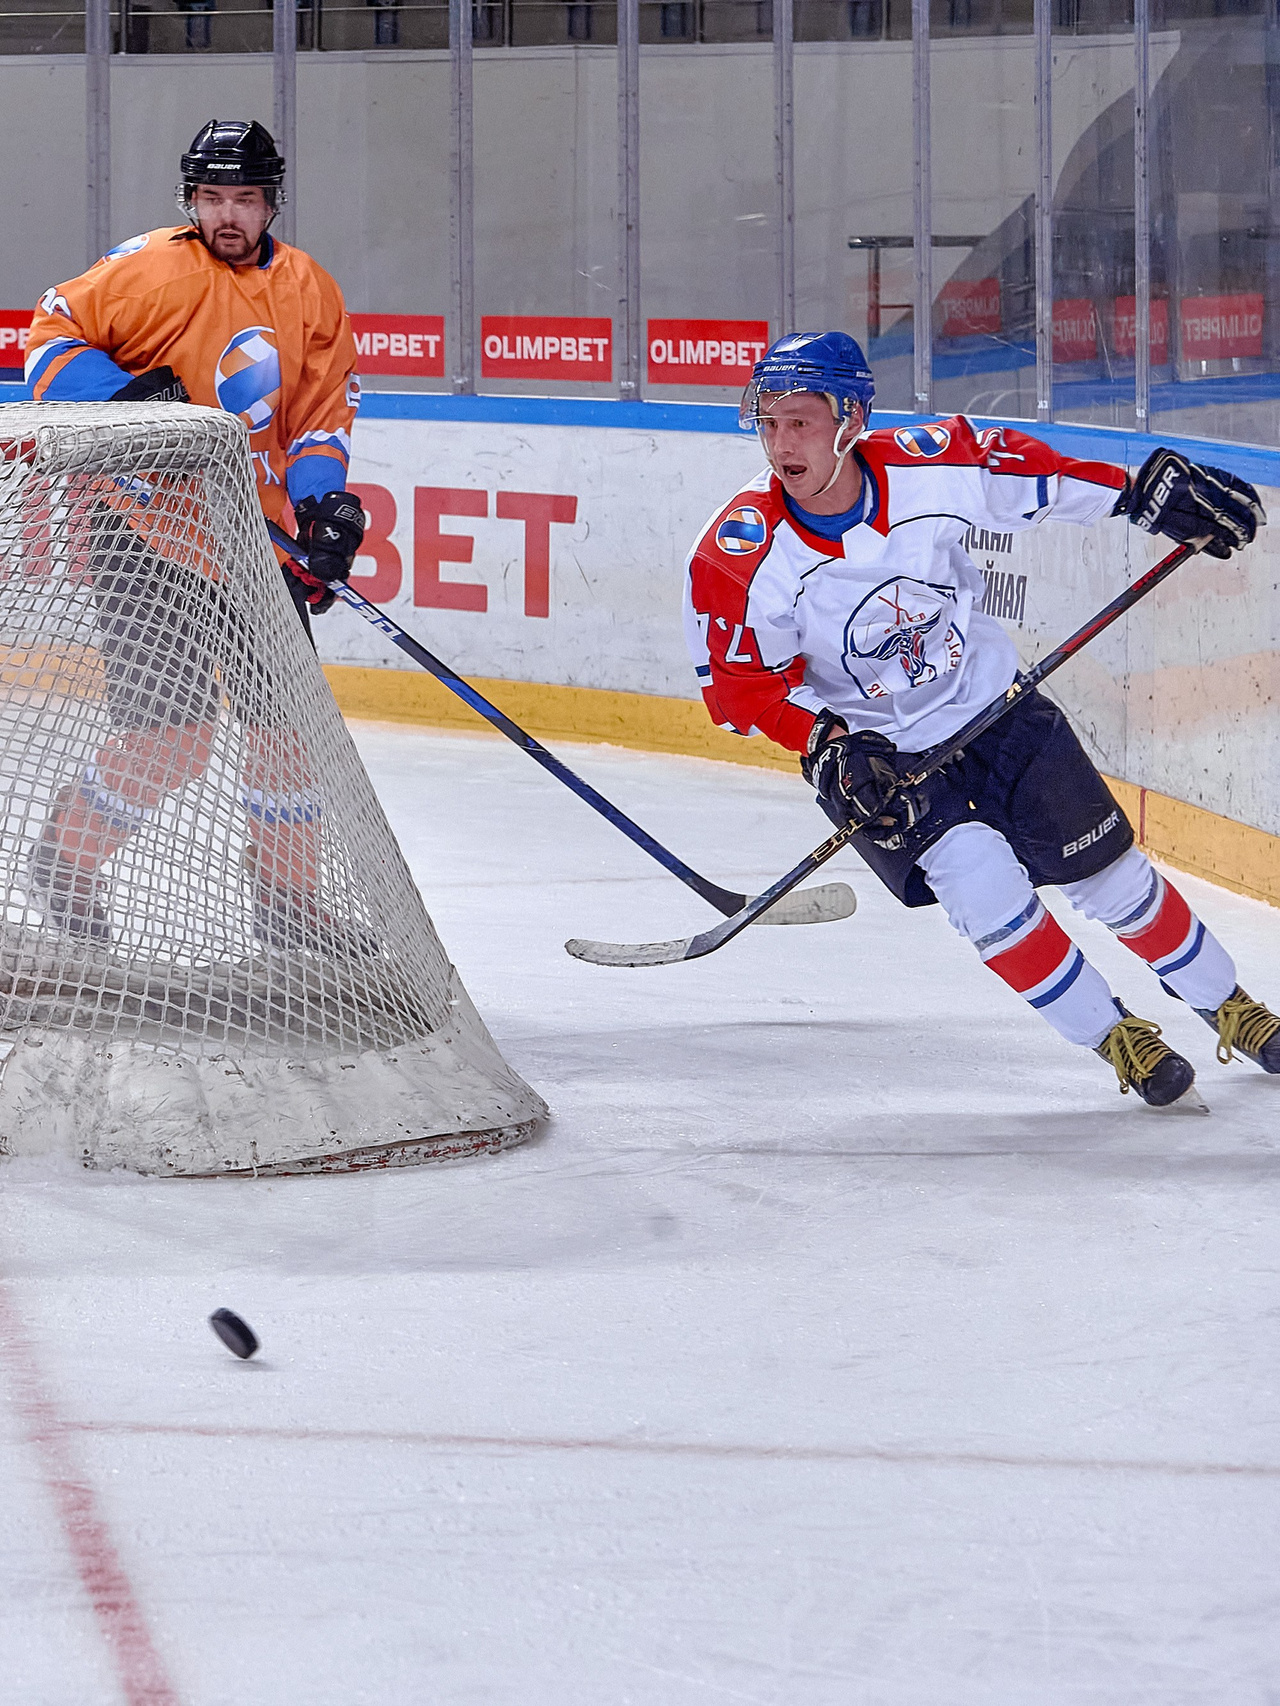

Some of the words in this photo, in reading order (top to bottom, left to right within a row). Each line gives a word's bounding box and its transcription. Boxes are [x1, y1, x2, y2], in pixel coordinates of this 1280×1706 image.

[352, 332, 441, 359] MPBET
[483, 334, 609, 363] OLIMPBET
[649, 338, 767, 367] OLIMPBET
[762, 364, 797, 372] BAUER
[1136, 465, 1180, 531] AUER
[980, 559, 1028, 621] ЙНАЯ
[1062, 810, 1120, 859] BAUER
